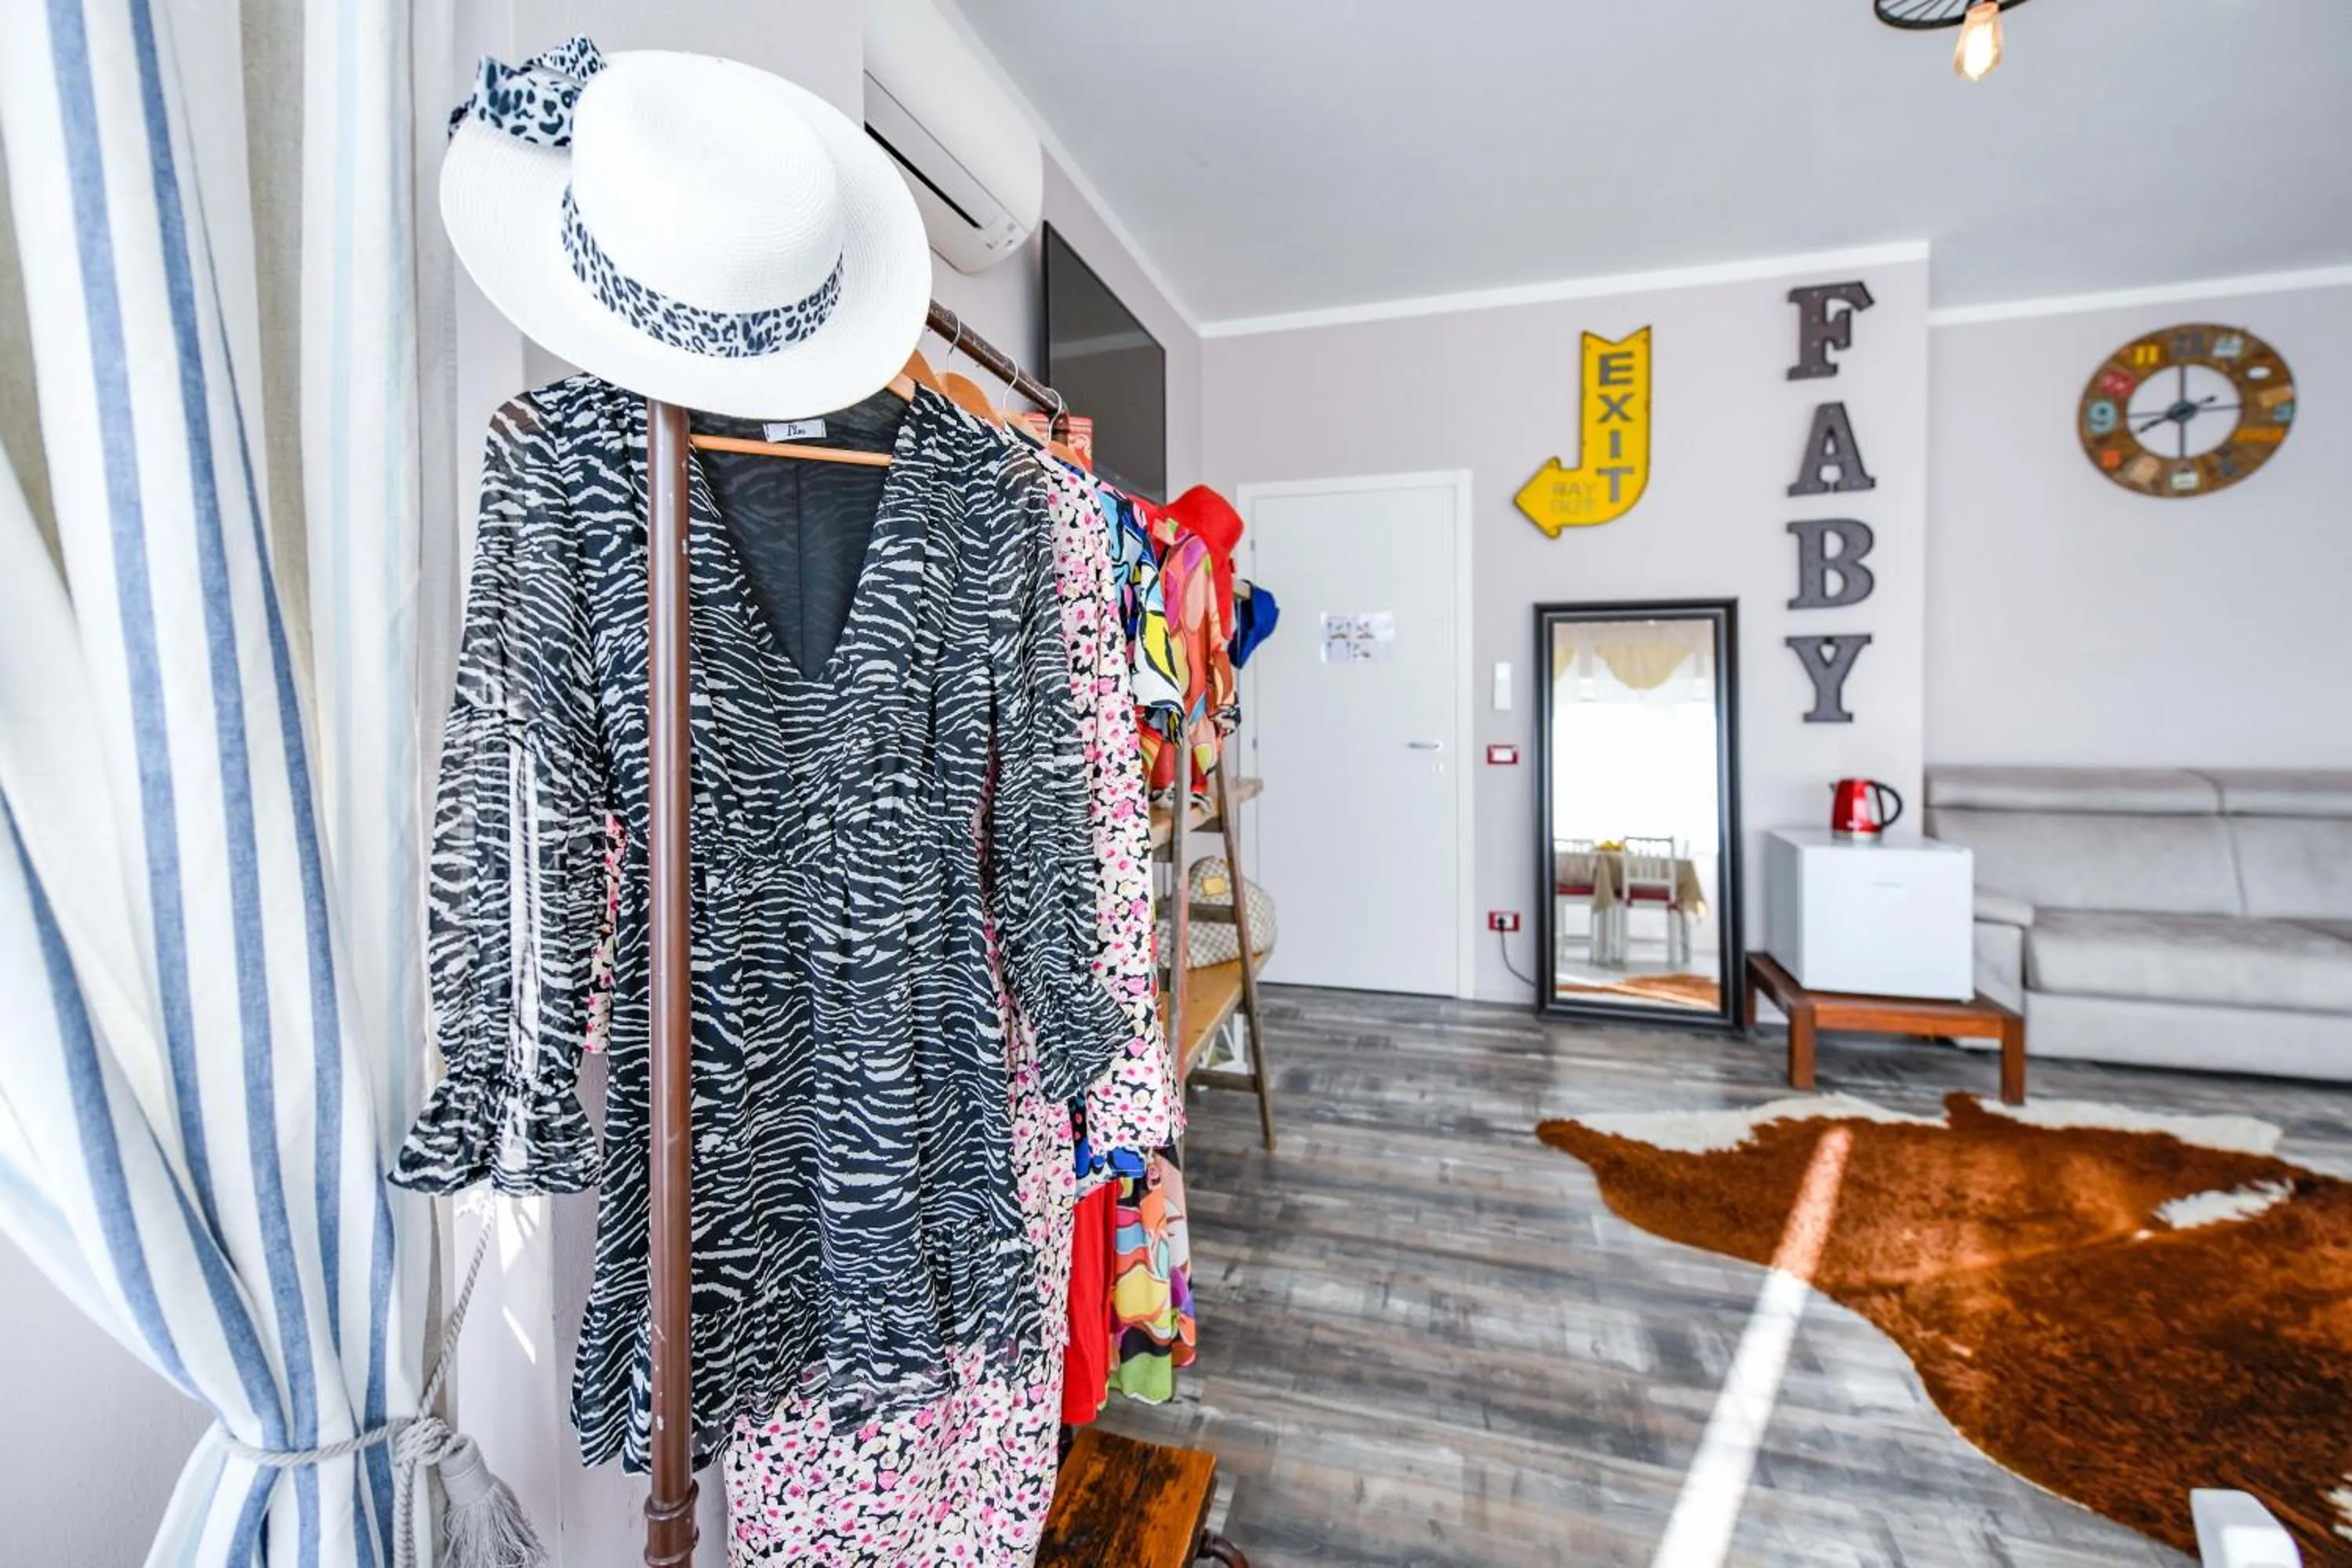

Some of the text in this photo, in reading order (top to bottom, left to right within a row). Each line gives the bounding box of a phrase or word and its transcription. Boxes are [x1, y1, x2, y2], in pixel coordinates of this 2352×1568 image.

[1596, 350, 1635, 503] EXIT
[2088, 401, 2117, 436] 9
[1786, 281, 1875, 723] FABY
